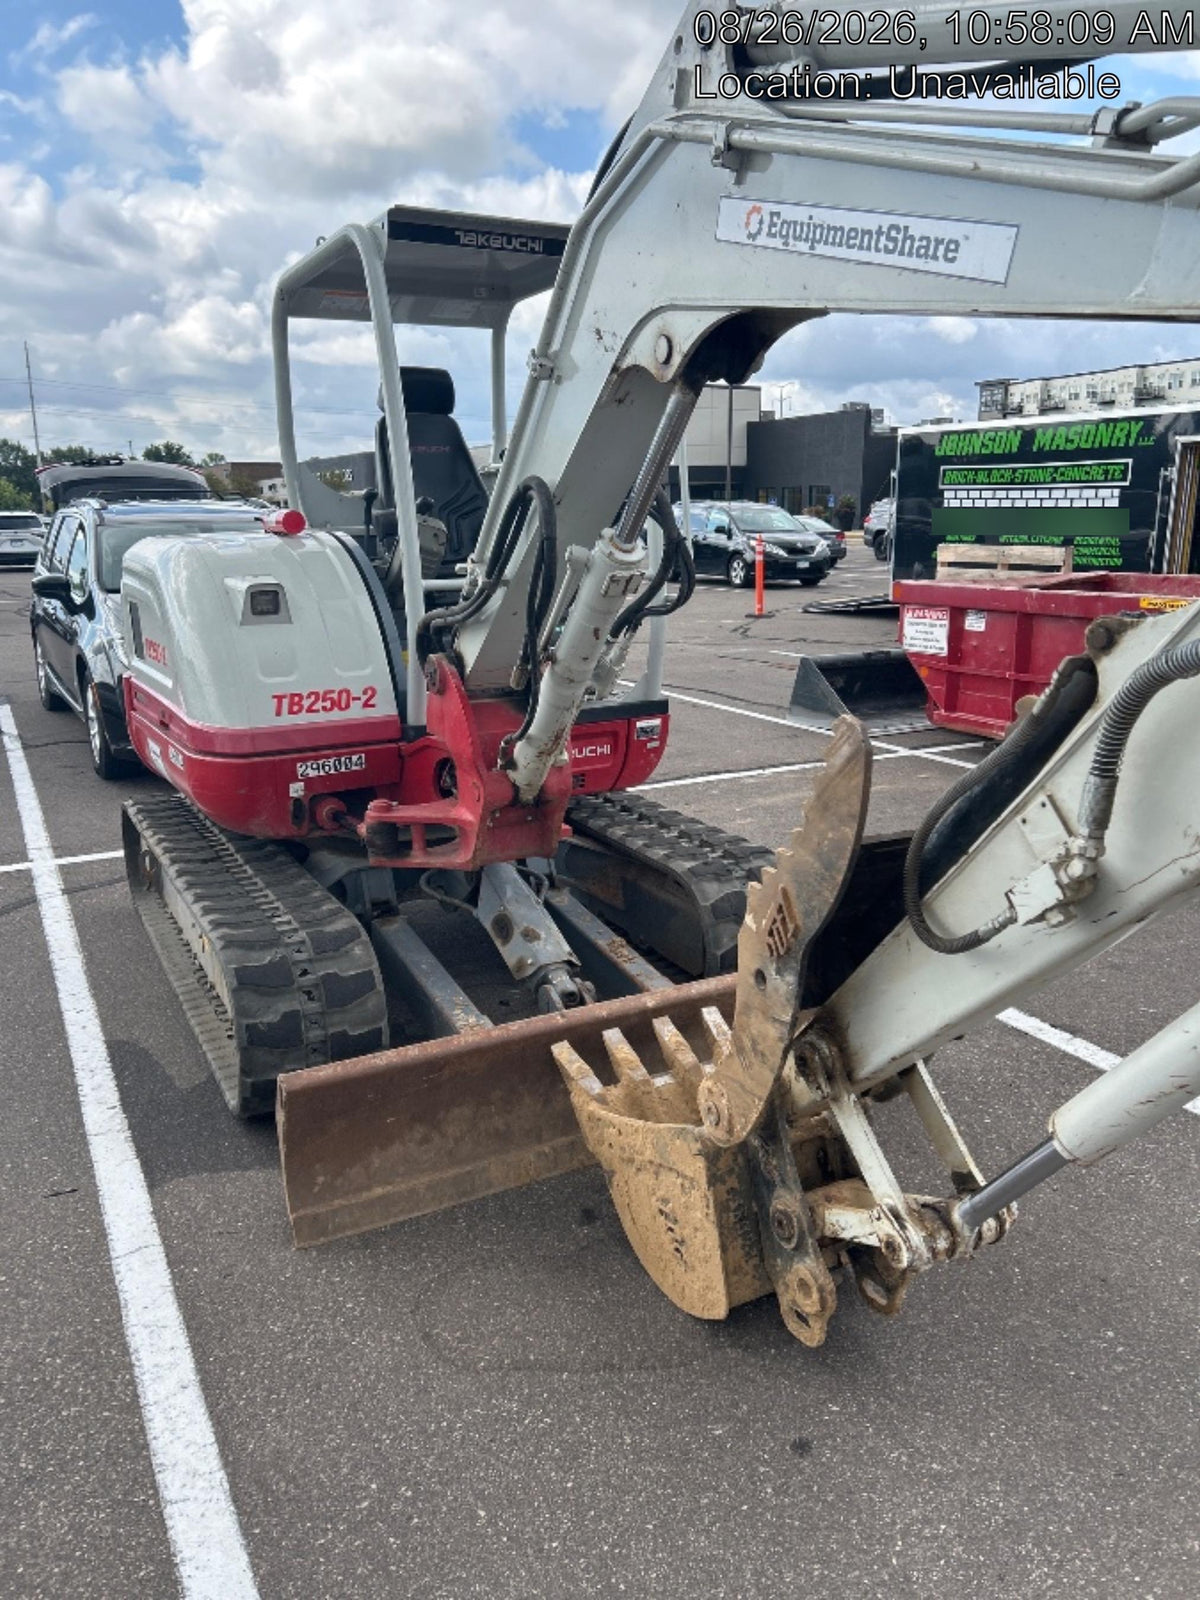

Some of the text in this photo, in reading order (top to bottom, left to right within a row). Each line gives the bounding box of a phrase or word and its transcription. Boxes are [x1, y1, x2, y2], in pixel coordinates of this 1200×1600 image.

[767, 211, 960, 264] EquipmentShare
[935, 429, 1022, 457] JOHNSON
[1033, 421, 1144, 451] MASONRY
[272, 686, 378, 717] TB250-2
[299, 756, 364, 777] 296004
